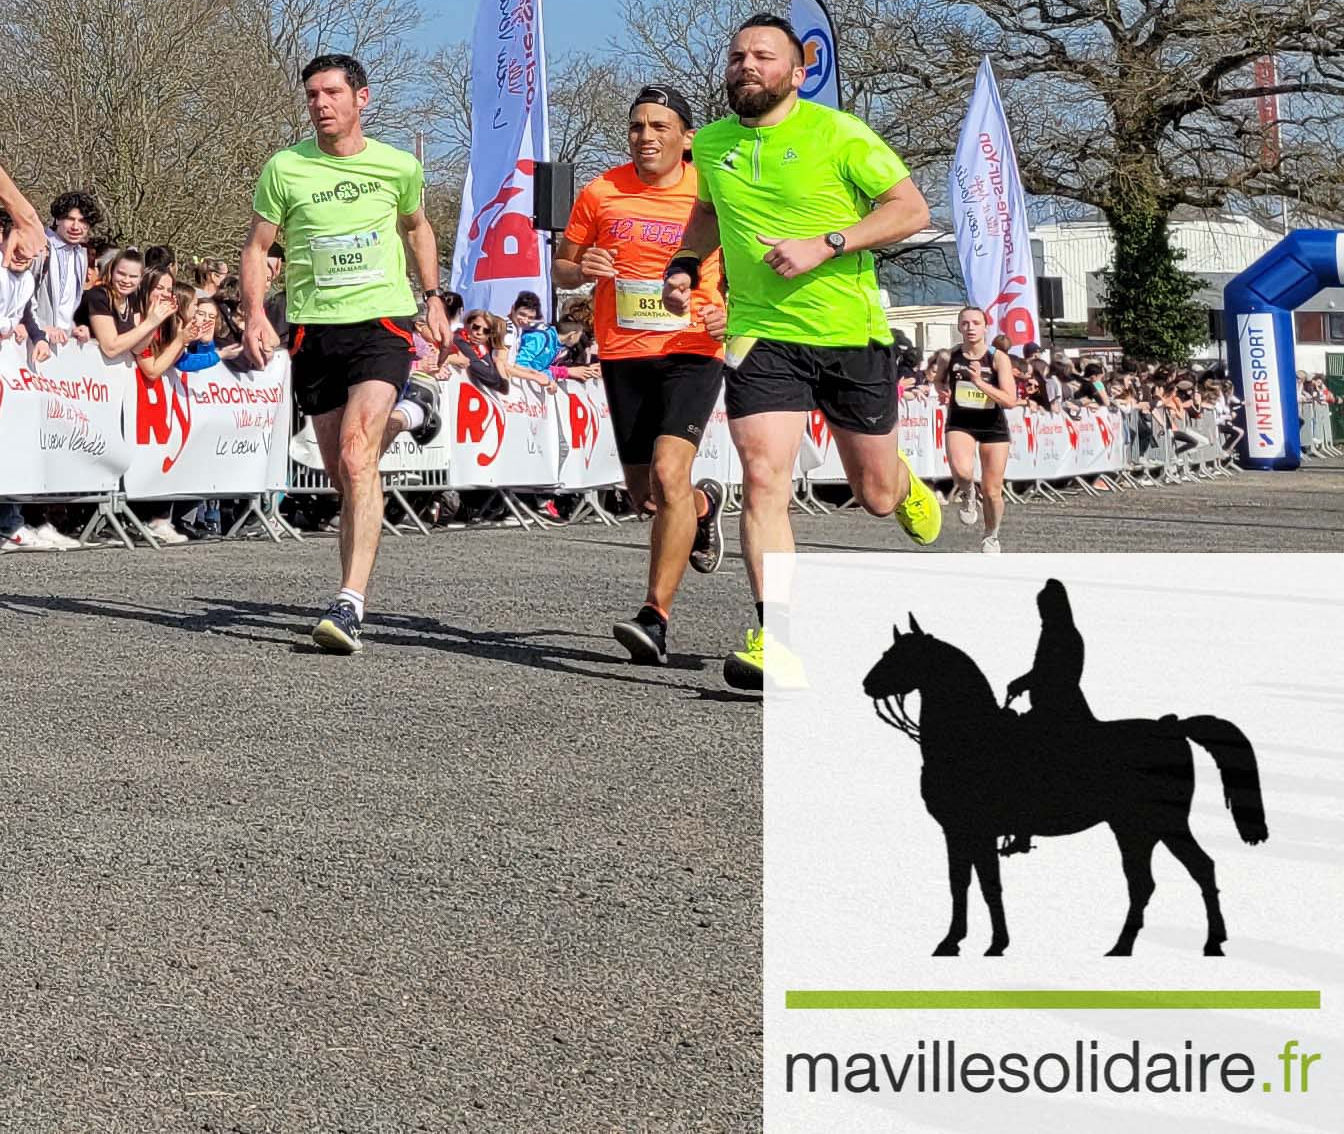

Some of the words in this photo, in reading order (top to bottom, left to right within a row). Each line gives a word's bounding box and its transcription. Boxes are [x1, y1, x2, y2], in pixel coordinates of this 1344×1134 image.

[337, 189, 358, 200] PAS
[339, 182, 353, 192] OU
[359, 181, 382, 195] CAP
[312, 190, 333, 204] CAP
[331, 252, 363, 266] 1629
[19, 367, 109, 403] Roche-sur-Yon
[1247, 326, 1273, 431] INTERSPORT
[192, 387, 210, 405] La
[457, 382, 506, 467] Ry
[216, 434, 228, 456] Le
